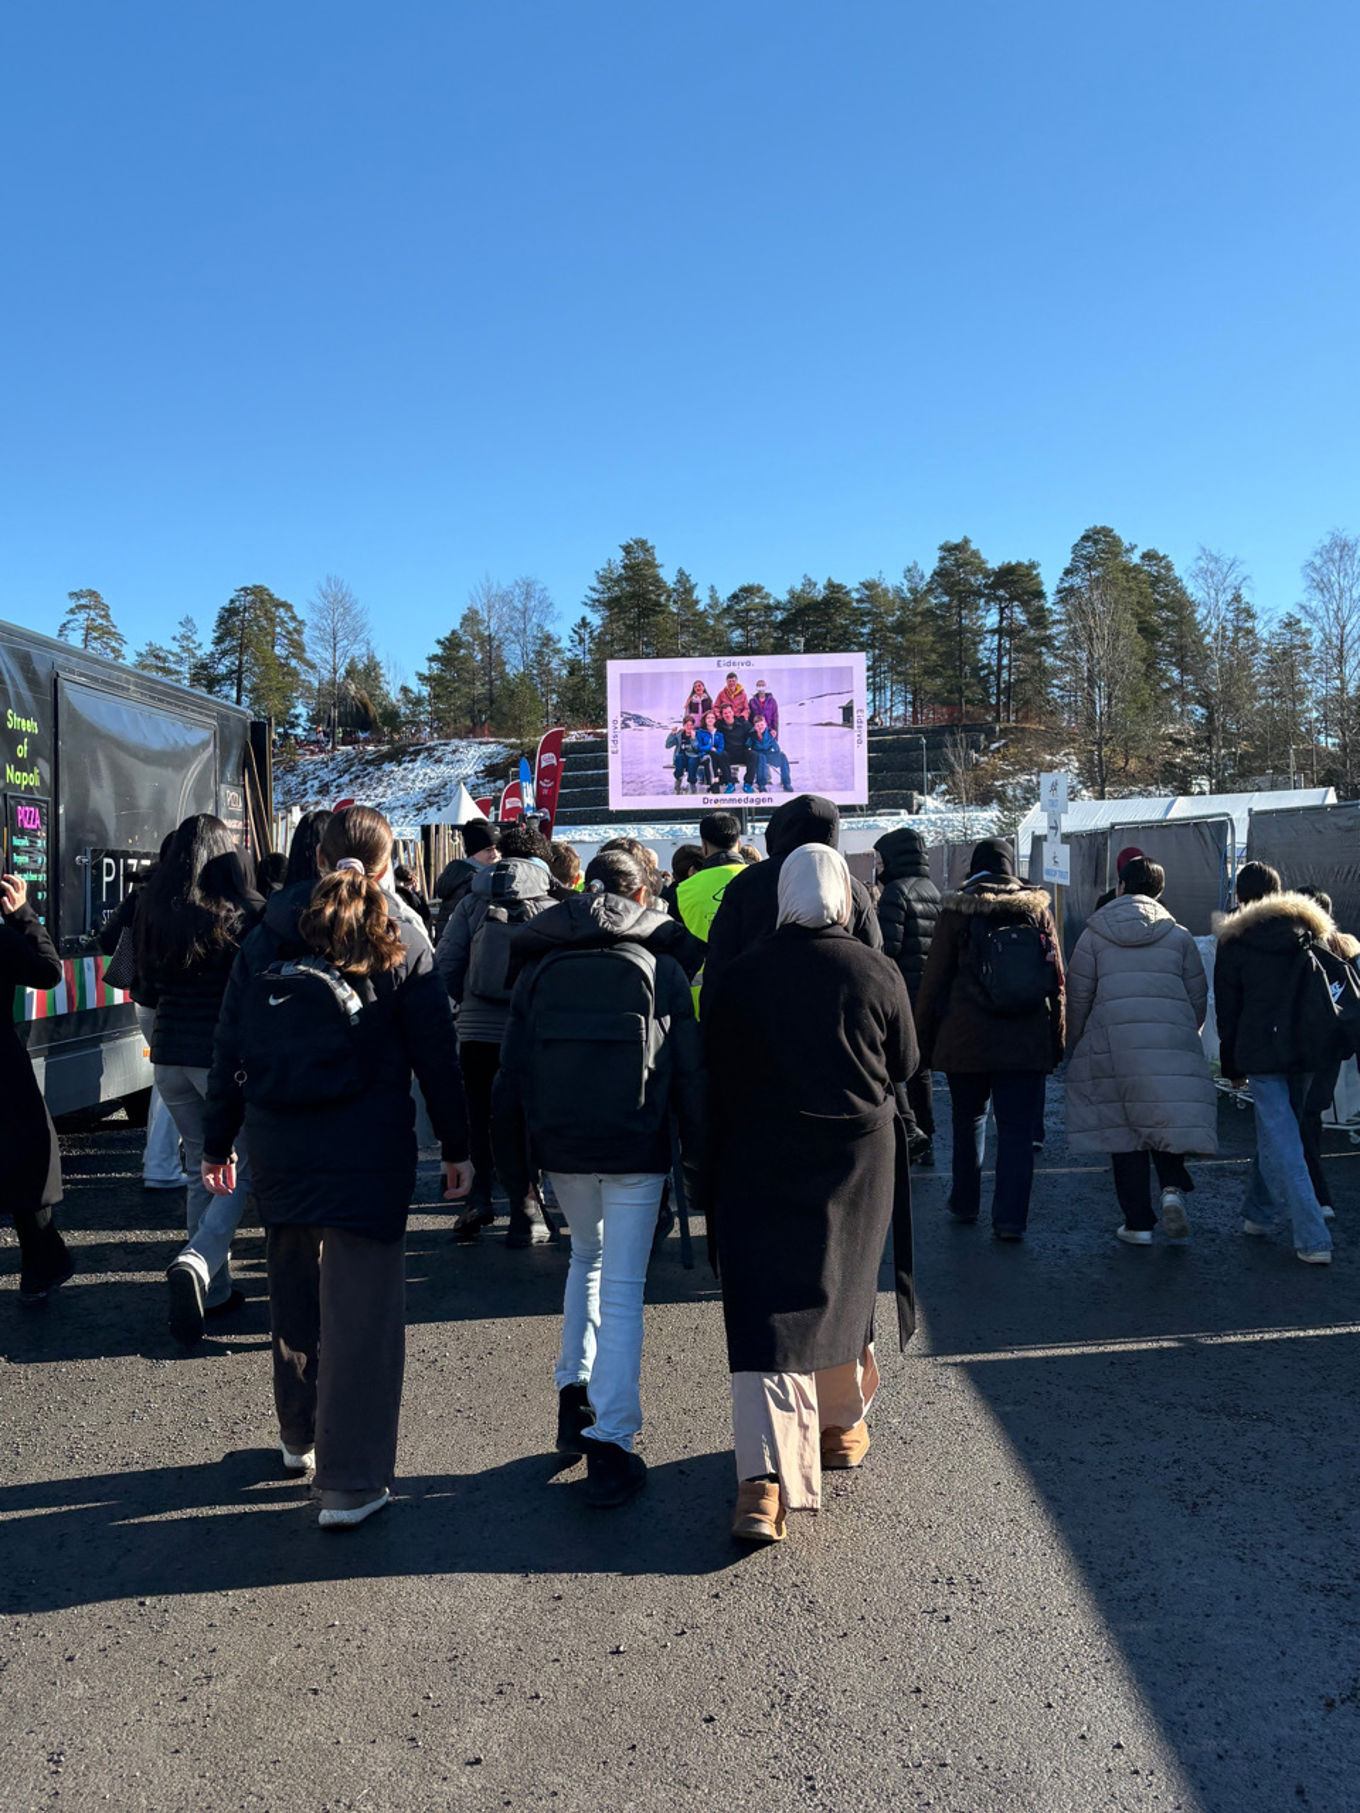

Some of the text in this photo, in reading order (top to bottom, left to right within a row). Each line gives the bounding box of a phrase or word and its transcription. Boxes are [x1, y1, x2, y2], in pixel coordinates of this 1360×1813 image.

[6, 708, 39, 735] Streets
[16, 737, 28, 759] of
[5, 763, 40, 791] Napoli
[702, 795, 773, 806] Drømmedagen
[16, 805, 41, 830] PIZZA
[102, 857, 152, 902] PIZ
